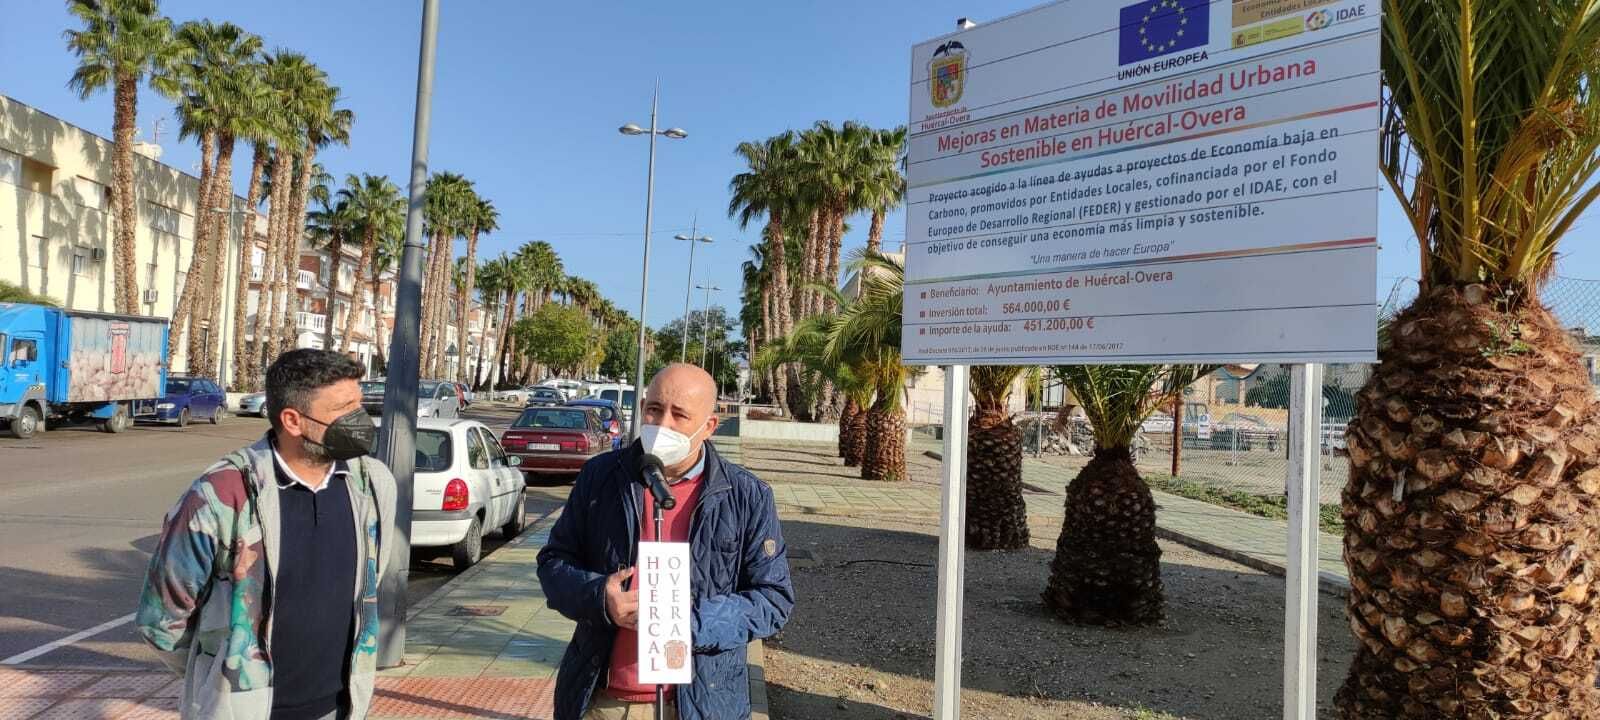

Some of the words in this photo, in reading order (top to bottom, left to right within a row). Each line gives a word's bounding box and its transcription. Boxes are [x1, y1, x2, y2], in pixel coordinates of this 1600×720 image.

[1336, 4, 1365, 21] IDAE
[1118, 64, 1150, 80] UNIÓN
[1153, 51, 1208, 71] EUROPEA
[938, 128, 996, 153] Mejoras
[1000, 123, 1019, 139] en
[1025, 105, 1089, 134] Materia
[1096, 100, 1117, 119] de
[1123, 73, 1223, 115] Movilidad
[1231, 59, 1316, 91] Urbana
[981, 138, 1066, 169] Sostenible
[1072, 134, 1092, 151] en
[1099, 105, 1246, 146] Huércal-Overa
[928, 207, 967, 220] Carbono,
[970, 195, 1027, 216] promovidos
[1030, 193, 1046, 207] por
[1050, 186, 1102, 202] Entidades
[1106, 179, 1152, 195] Locales,
[1156, 164, 1238, 187] cofinanciada
[1244, 160, 1267, 176] por
[1273, 155, 1284, 169] el
[1290, 148, 1337, 167] Fondo
[929, 188, 967, 204] Proyecto
[970, 181, 1006, 197] acogido
[1010, 181, 1015, 190] a
[1018, 178, 1026, 188] la
[1031, 174, 1055, 187] línea
[1059, 171, 1071, 182] de
[1074, 165, 1112, 181] ayudas
[1116, 163, 1122, 173] a
[1127, 153, 1187, 174] proyectos
[1191, 148, 1206, 161] de
[1211, 135, 1278, 157] Economía
[1284, 129, 1314, 146] baja
[1320, 127, 1339, 139] en
[928, 224, 963, 237] Europeo
[966, 221, 977, 232] de
[980, 215, 1029, 231] Desarrollo
[1032, 207, 1075, 224] Regional
[1079, 201, 1121, 219] (FEDER)
[1125, 202, 1132, 214] y
[1134, 190, 1202, 213] gestionado
[1206, 188, 1229, 204] por
[1233, 183, 1244, 197] el
[1250, 178, 1287, 194] IDAE,
[1292, 176, 1318, 189] con
[1324, 170, 1336, 184] el
[927, 241, 964, 255] objetivo
[967, 239, 978, 249] de
[981, 233, 1028, 248] conseguir
[1030, 231, 1049, 242] una
[1052, 223, 1105, 240] economía
[1109, 218, 1132, 233] más
[1136, 214, 1174, 230] limpia
[1178, 215, 1186, 227] y
[1190, 204, 1265, 223] sostenible.
[1089, 249, 1101, 258] de
[1103, 246, 1130, 257] hacer
[929, 306, 965, 318] Inversión
[966, 304, 989, 316] total:
[1003, 300, 1060, 314] 564.000,00
[1064, 299, 1071, 311] €
[930, 286, 979, 298] Beneficiario:
[987, 279, 1063, 296] Ayuntamiento
[1066, 276, 1079, 288] de
[1084, 270, 1173, 287] Huércal-Overa
[929, 325, 961, 336] Importe
[962, 323, 972, 333] de
[973, 322, 980, 332] la
[983, 321, 1012, 335] ayuda:
[1024, 318, 1083, 332] 451.200,00
[1087, 317, 1095, 328] €
[667, 556, 682, 637] OVERA
